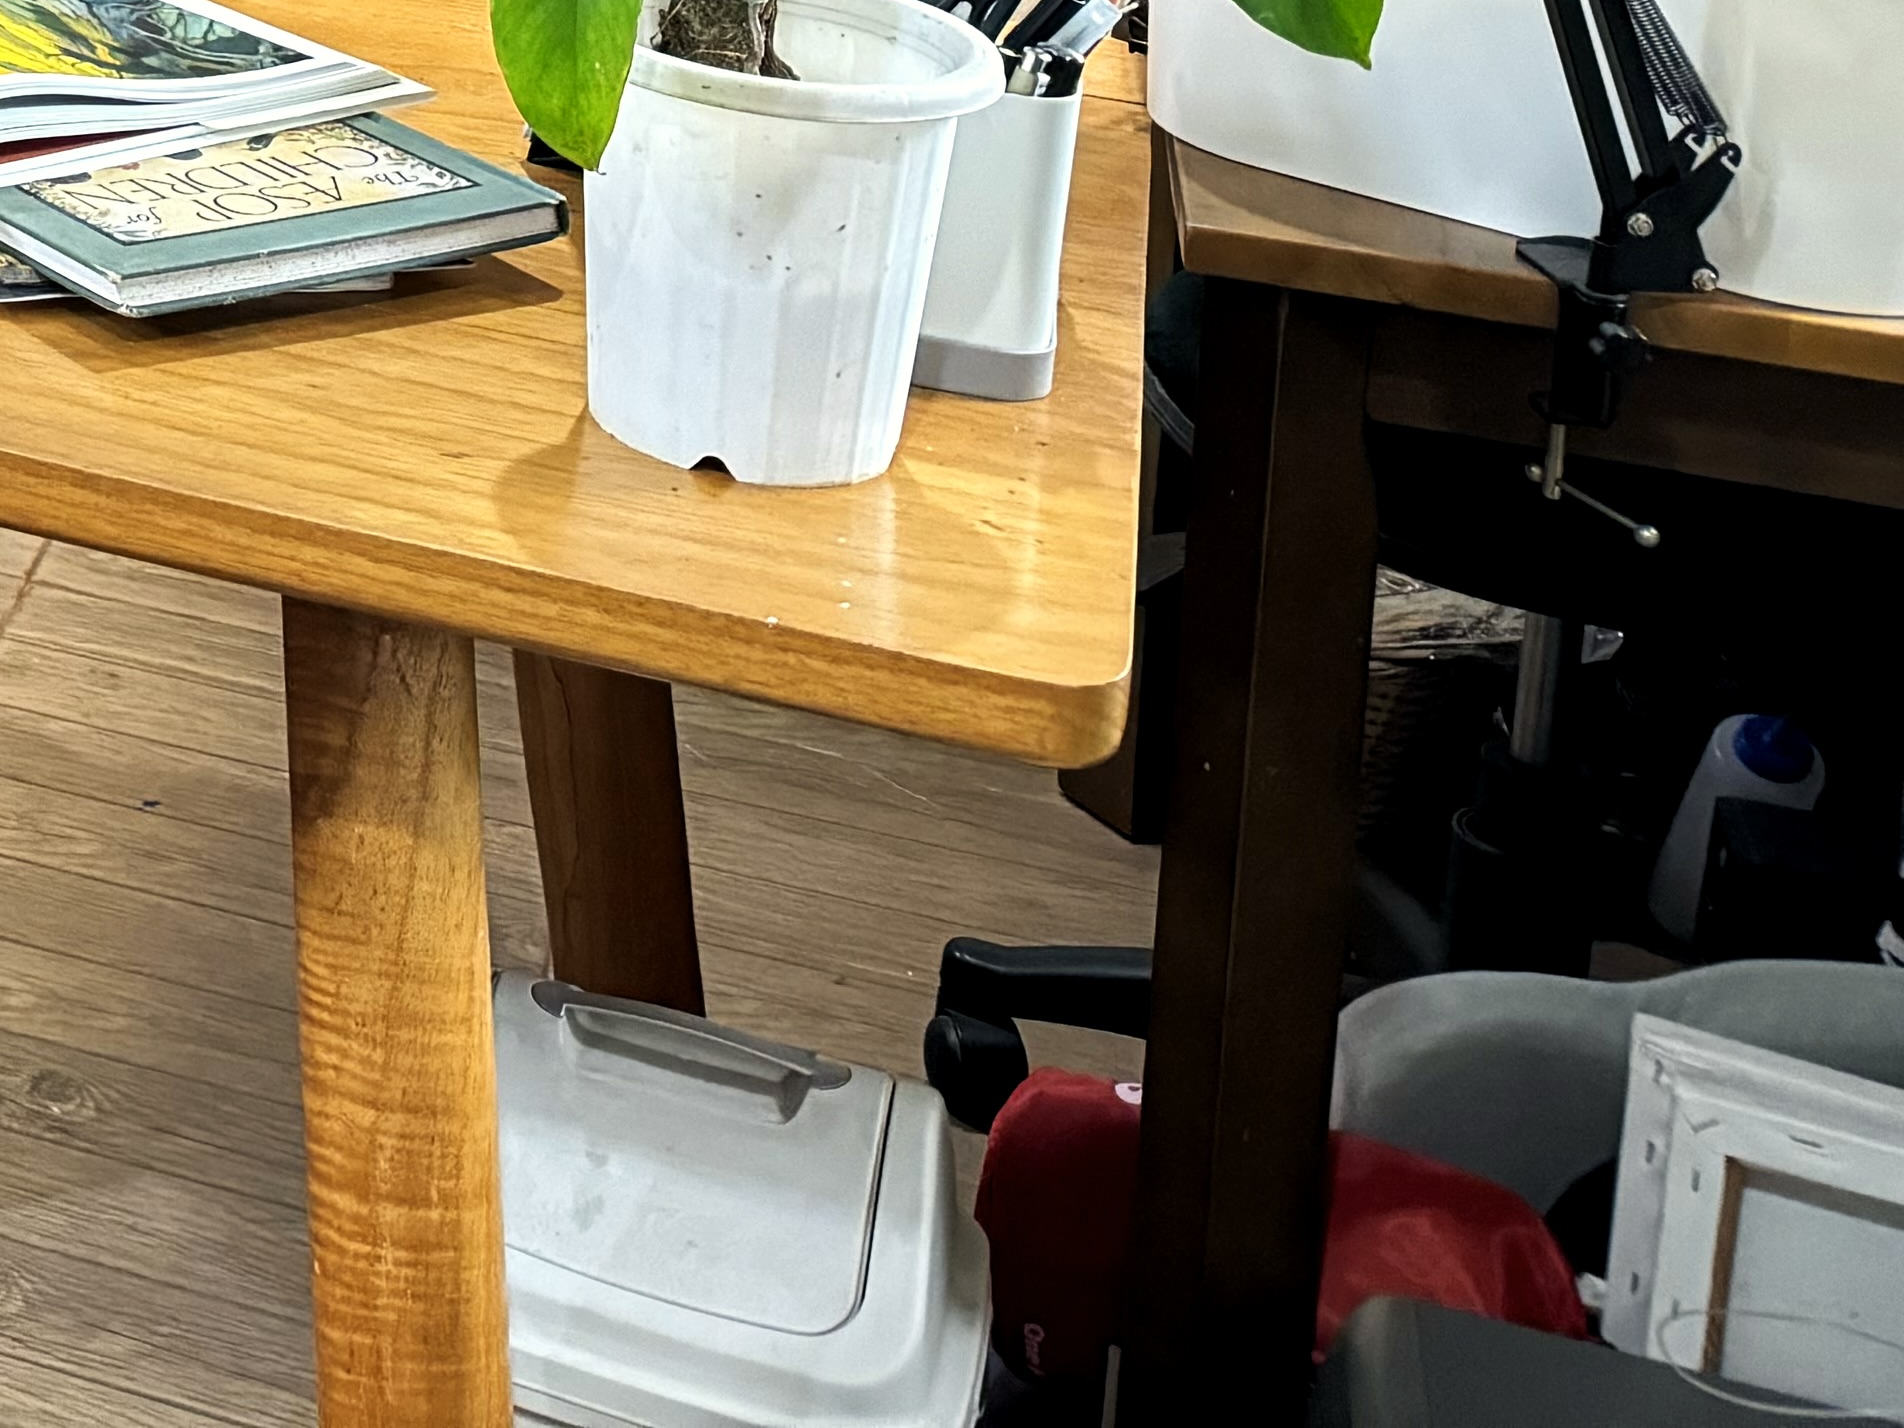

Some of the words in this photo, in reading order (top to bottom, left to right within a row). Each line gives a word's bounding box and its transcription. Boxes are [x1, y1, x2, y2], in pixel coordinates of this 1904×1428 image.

[57, 145, 379, 210] CHILDREN
[364, 170, 419, 189] The
[125, 206, 164, 226] for
